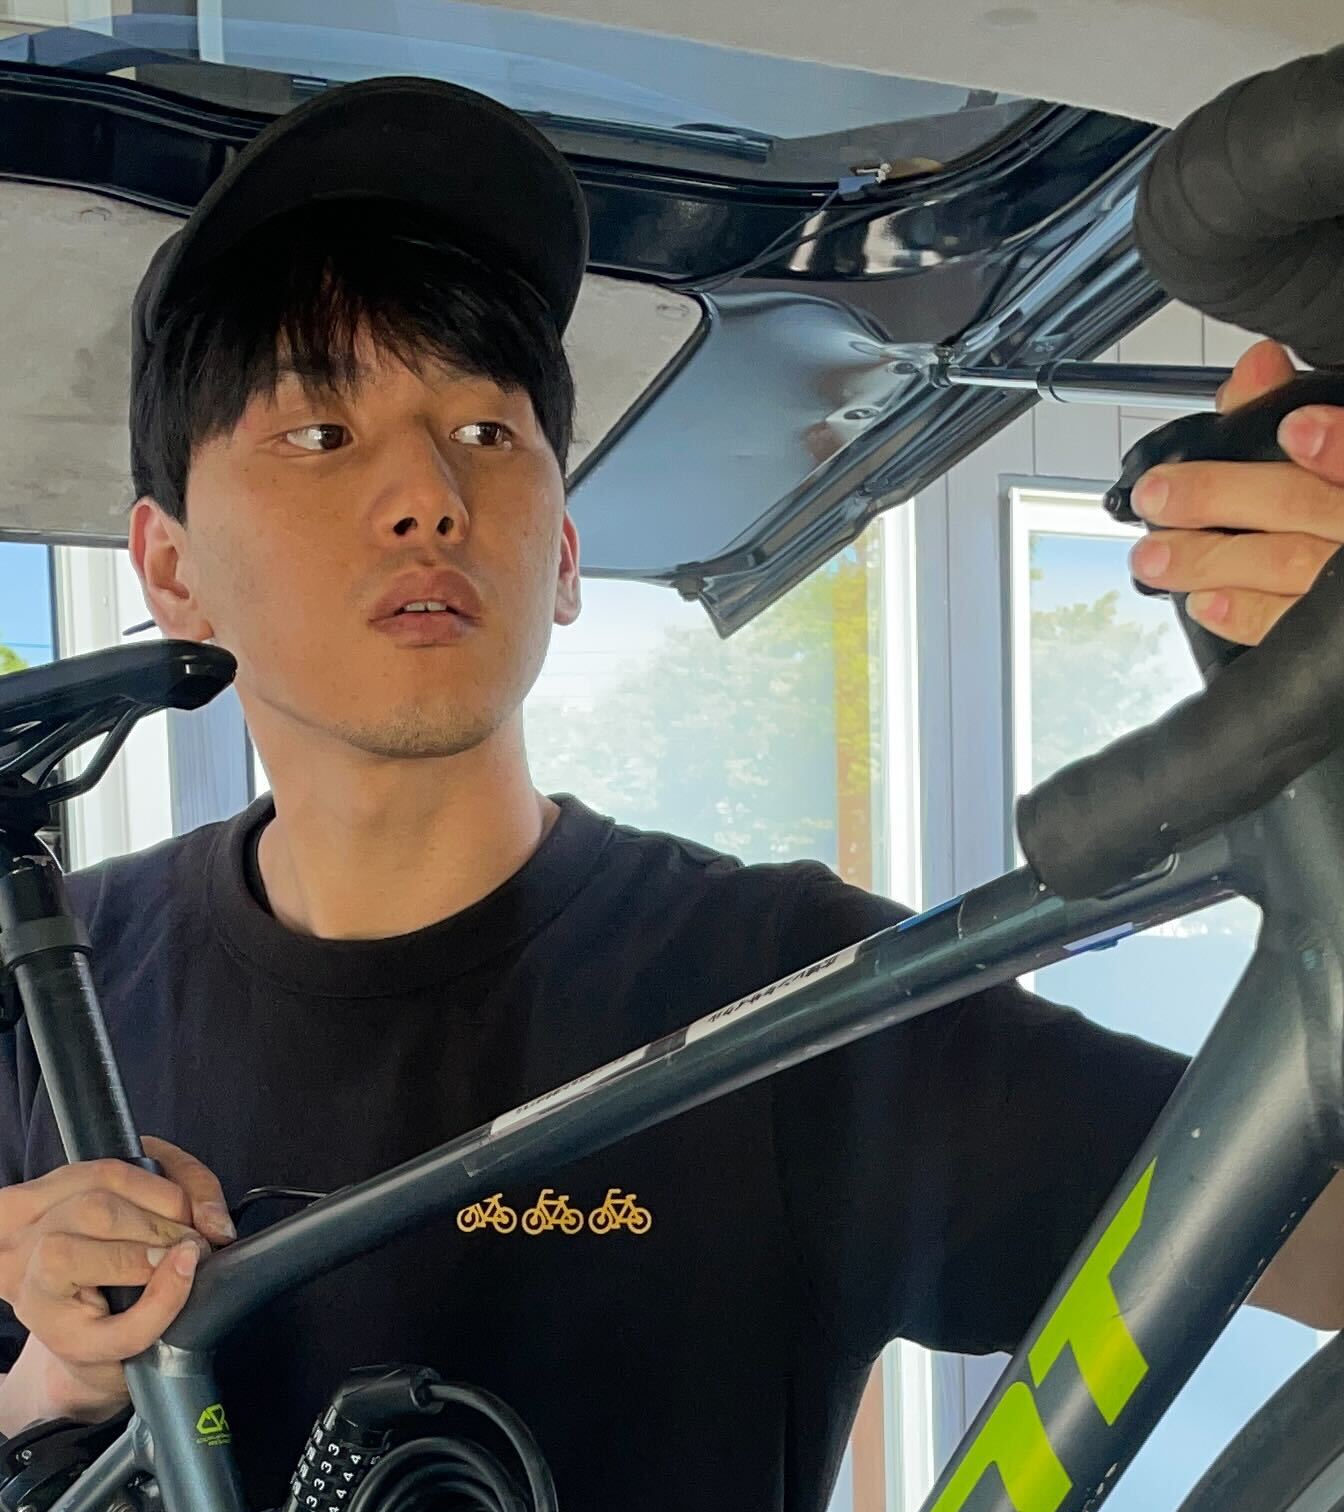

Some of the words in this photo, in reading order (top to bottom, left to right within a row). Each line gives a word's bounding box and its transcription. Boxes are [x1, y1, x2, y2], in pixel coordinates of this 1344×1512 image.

[306, 1495, 318, 1508] 3
[313, 1478, 325, 1491] 3
[320, 1461, 332, 1474] 3
[328, 1443, 340, 1456] 3
[335, 1489, 348, 1500] 4
[342, 1472, 355, 1482] 4
[350, 1454, 362, 1465] 4
